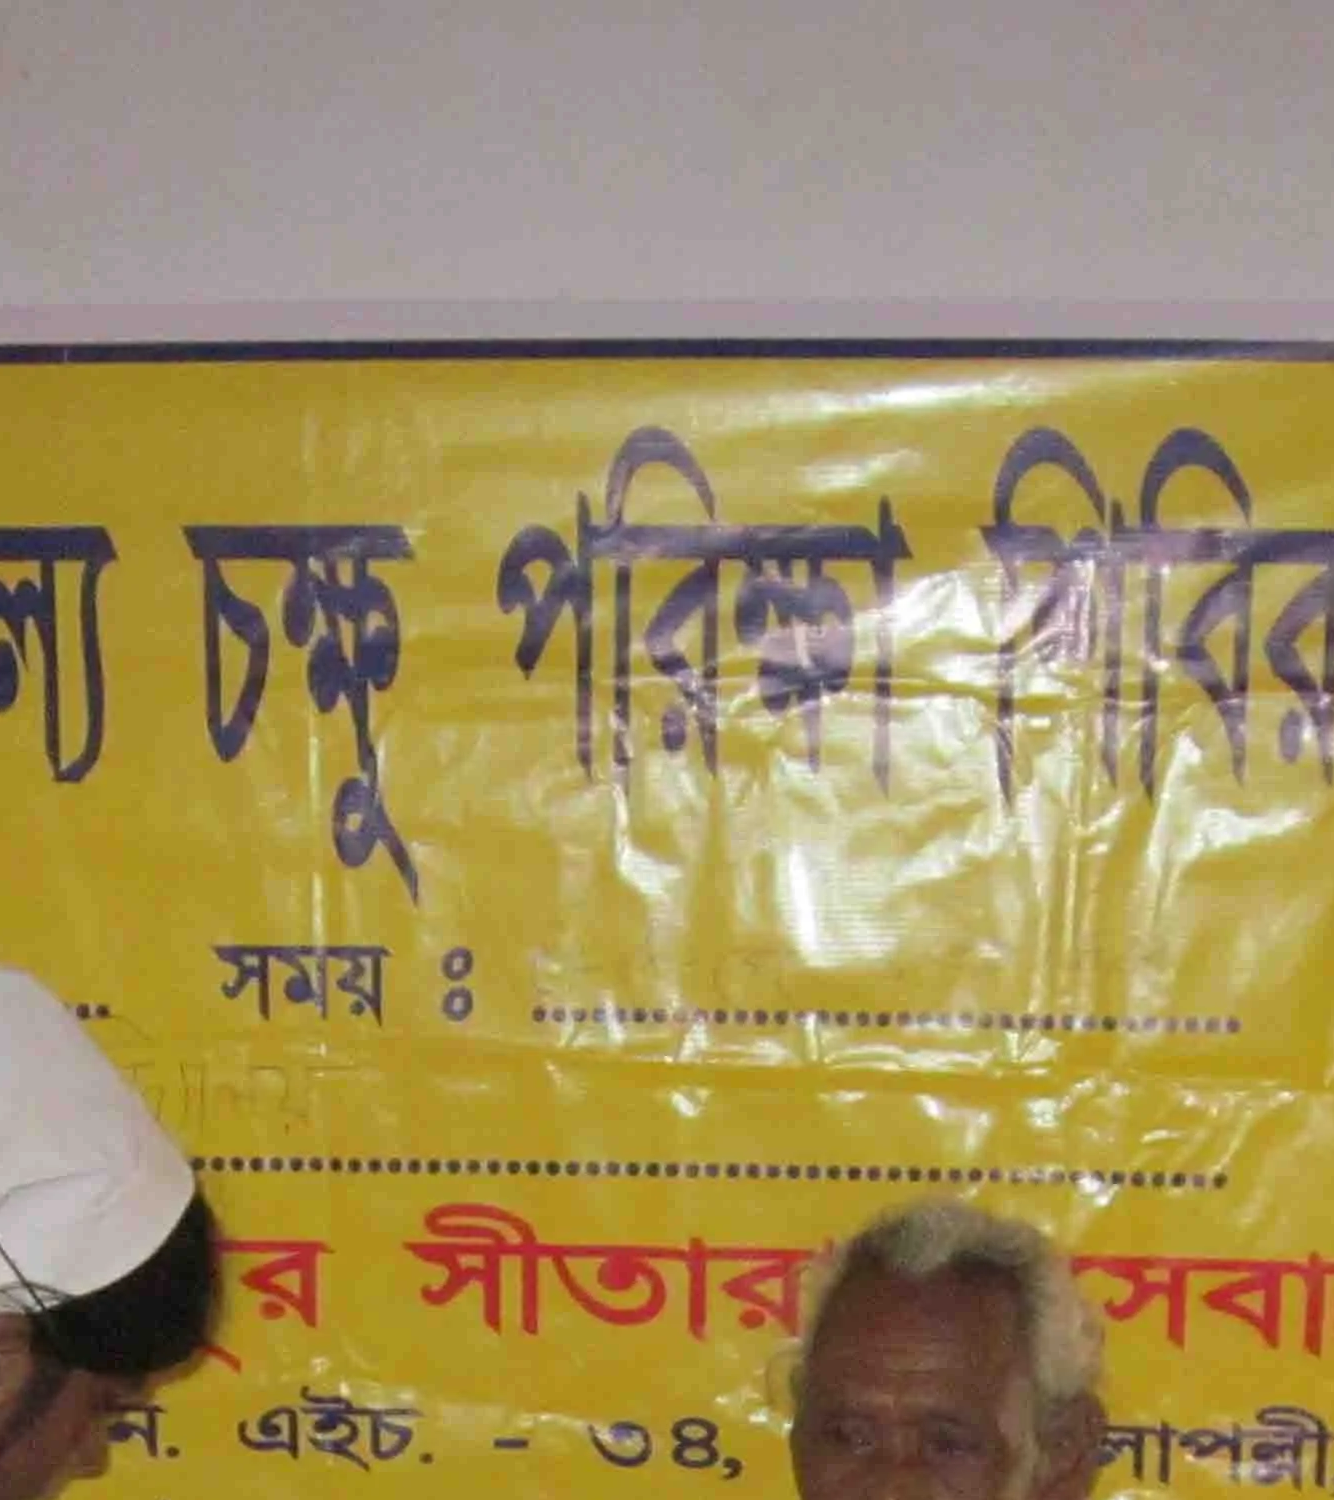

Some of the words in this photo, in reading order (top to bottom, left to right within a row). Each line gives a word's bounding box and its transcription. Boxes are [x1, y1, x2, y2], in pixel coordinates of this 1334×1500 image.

[182, 525, 417, 905] চক্ষু
[212, 945, 395, 1027] সময়
[237, 1385, 434, 1474] এইচ.
